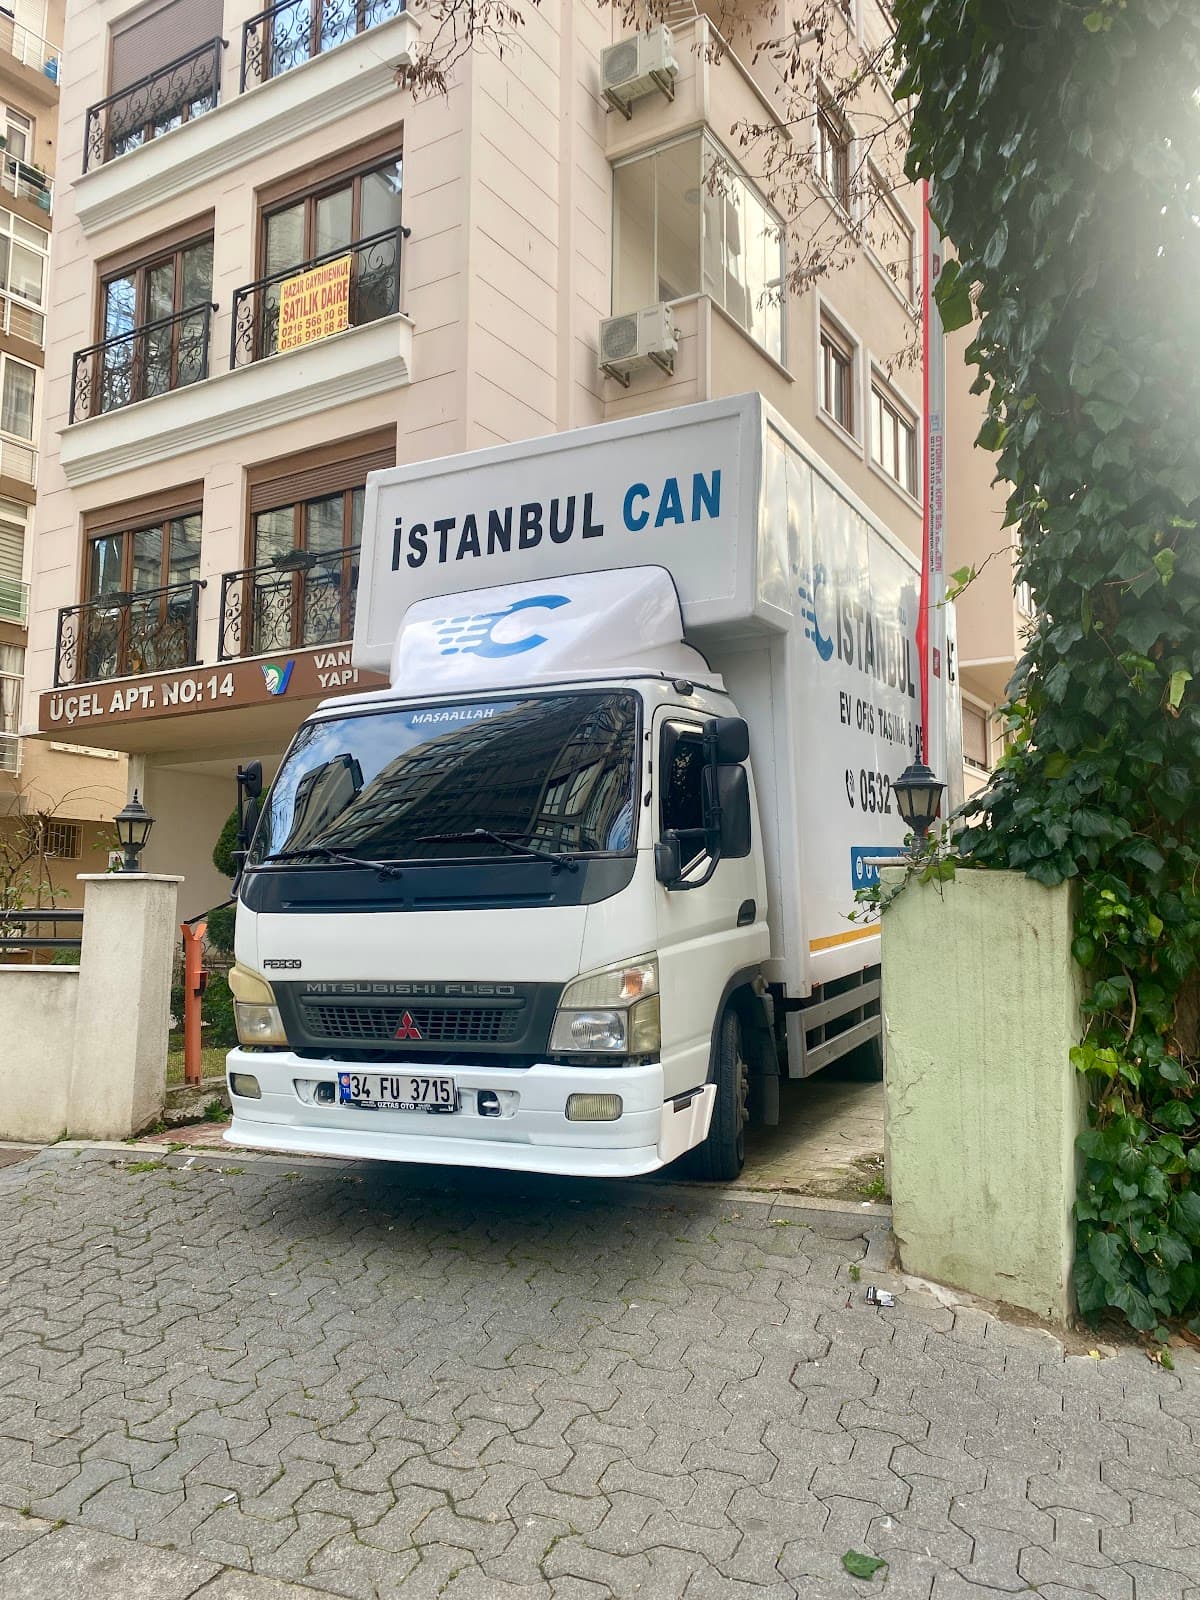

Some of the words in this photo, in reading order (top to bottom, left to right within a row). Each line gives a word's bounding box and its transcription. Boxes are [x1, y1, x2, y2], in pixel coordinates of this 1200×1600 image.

[283, 291, 319, 324] SATILIK
[281, 321, 303, 338] 0216
[305, 314, 322, 329] 566
[305, 326, 322, 341] 939
[392, 492, 604, 571] İSTANBUL
[623, 470, 721, 532] CAN
[316, 669, 358, 688] YAPI
[50, 694, 104, 724] ÜÇEL
[109, 685, 155, 713] APT.
[839, 691, 851, 726] EV
[860, 769, 892, 814] 0532
[306, 983, 436, 994] MITSUBISHI
[444, 984, 515, 995] FUSO
[351, 1075, 371, 1098] 34
[380, 1077, 400, 1100] FU
[410, 1078, 450, 1103] 3715
